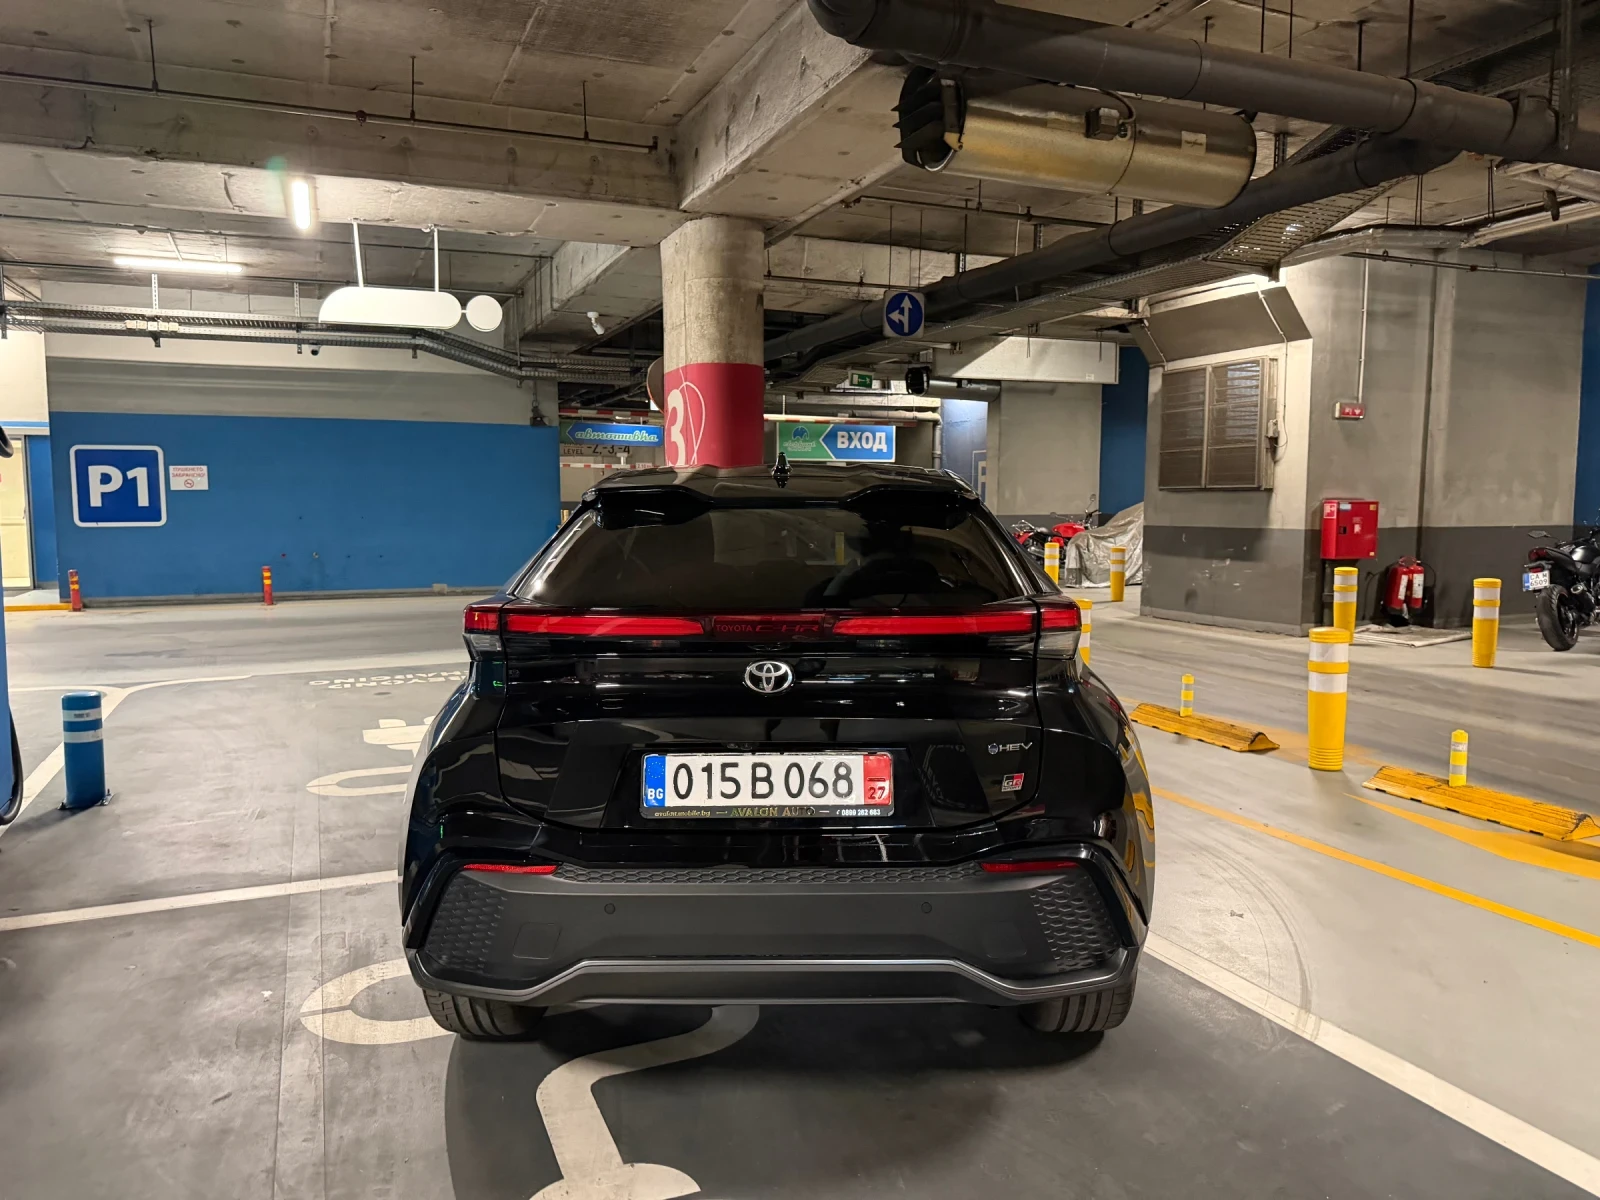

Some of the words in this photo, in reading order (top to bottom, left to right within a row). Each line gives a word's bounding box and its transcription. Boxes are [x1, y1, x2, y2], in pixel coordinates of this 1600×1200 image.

[837, 431, 888, 453] ВХОД
[88, 465, 150, 507] P1
[716, 624, 752, 632] TOYOTA
[755, 624, 819, 633] C-HR
[308, 670, 469, 686] HARGING
[999, 741, 1033, 752] HEV
[647, 788, 664, 800] BG
[867, 786, 886, 800] 27
[730, 807, 778, 817] AVALON
